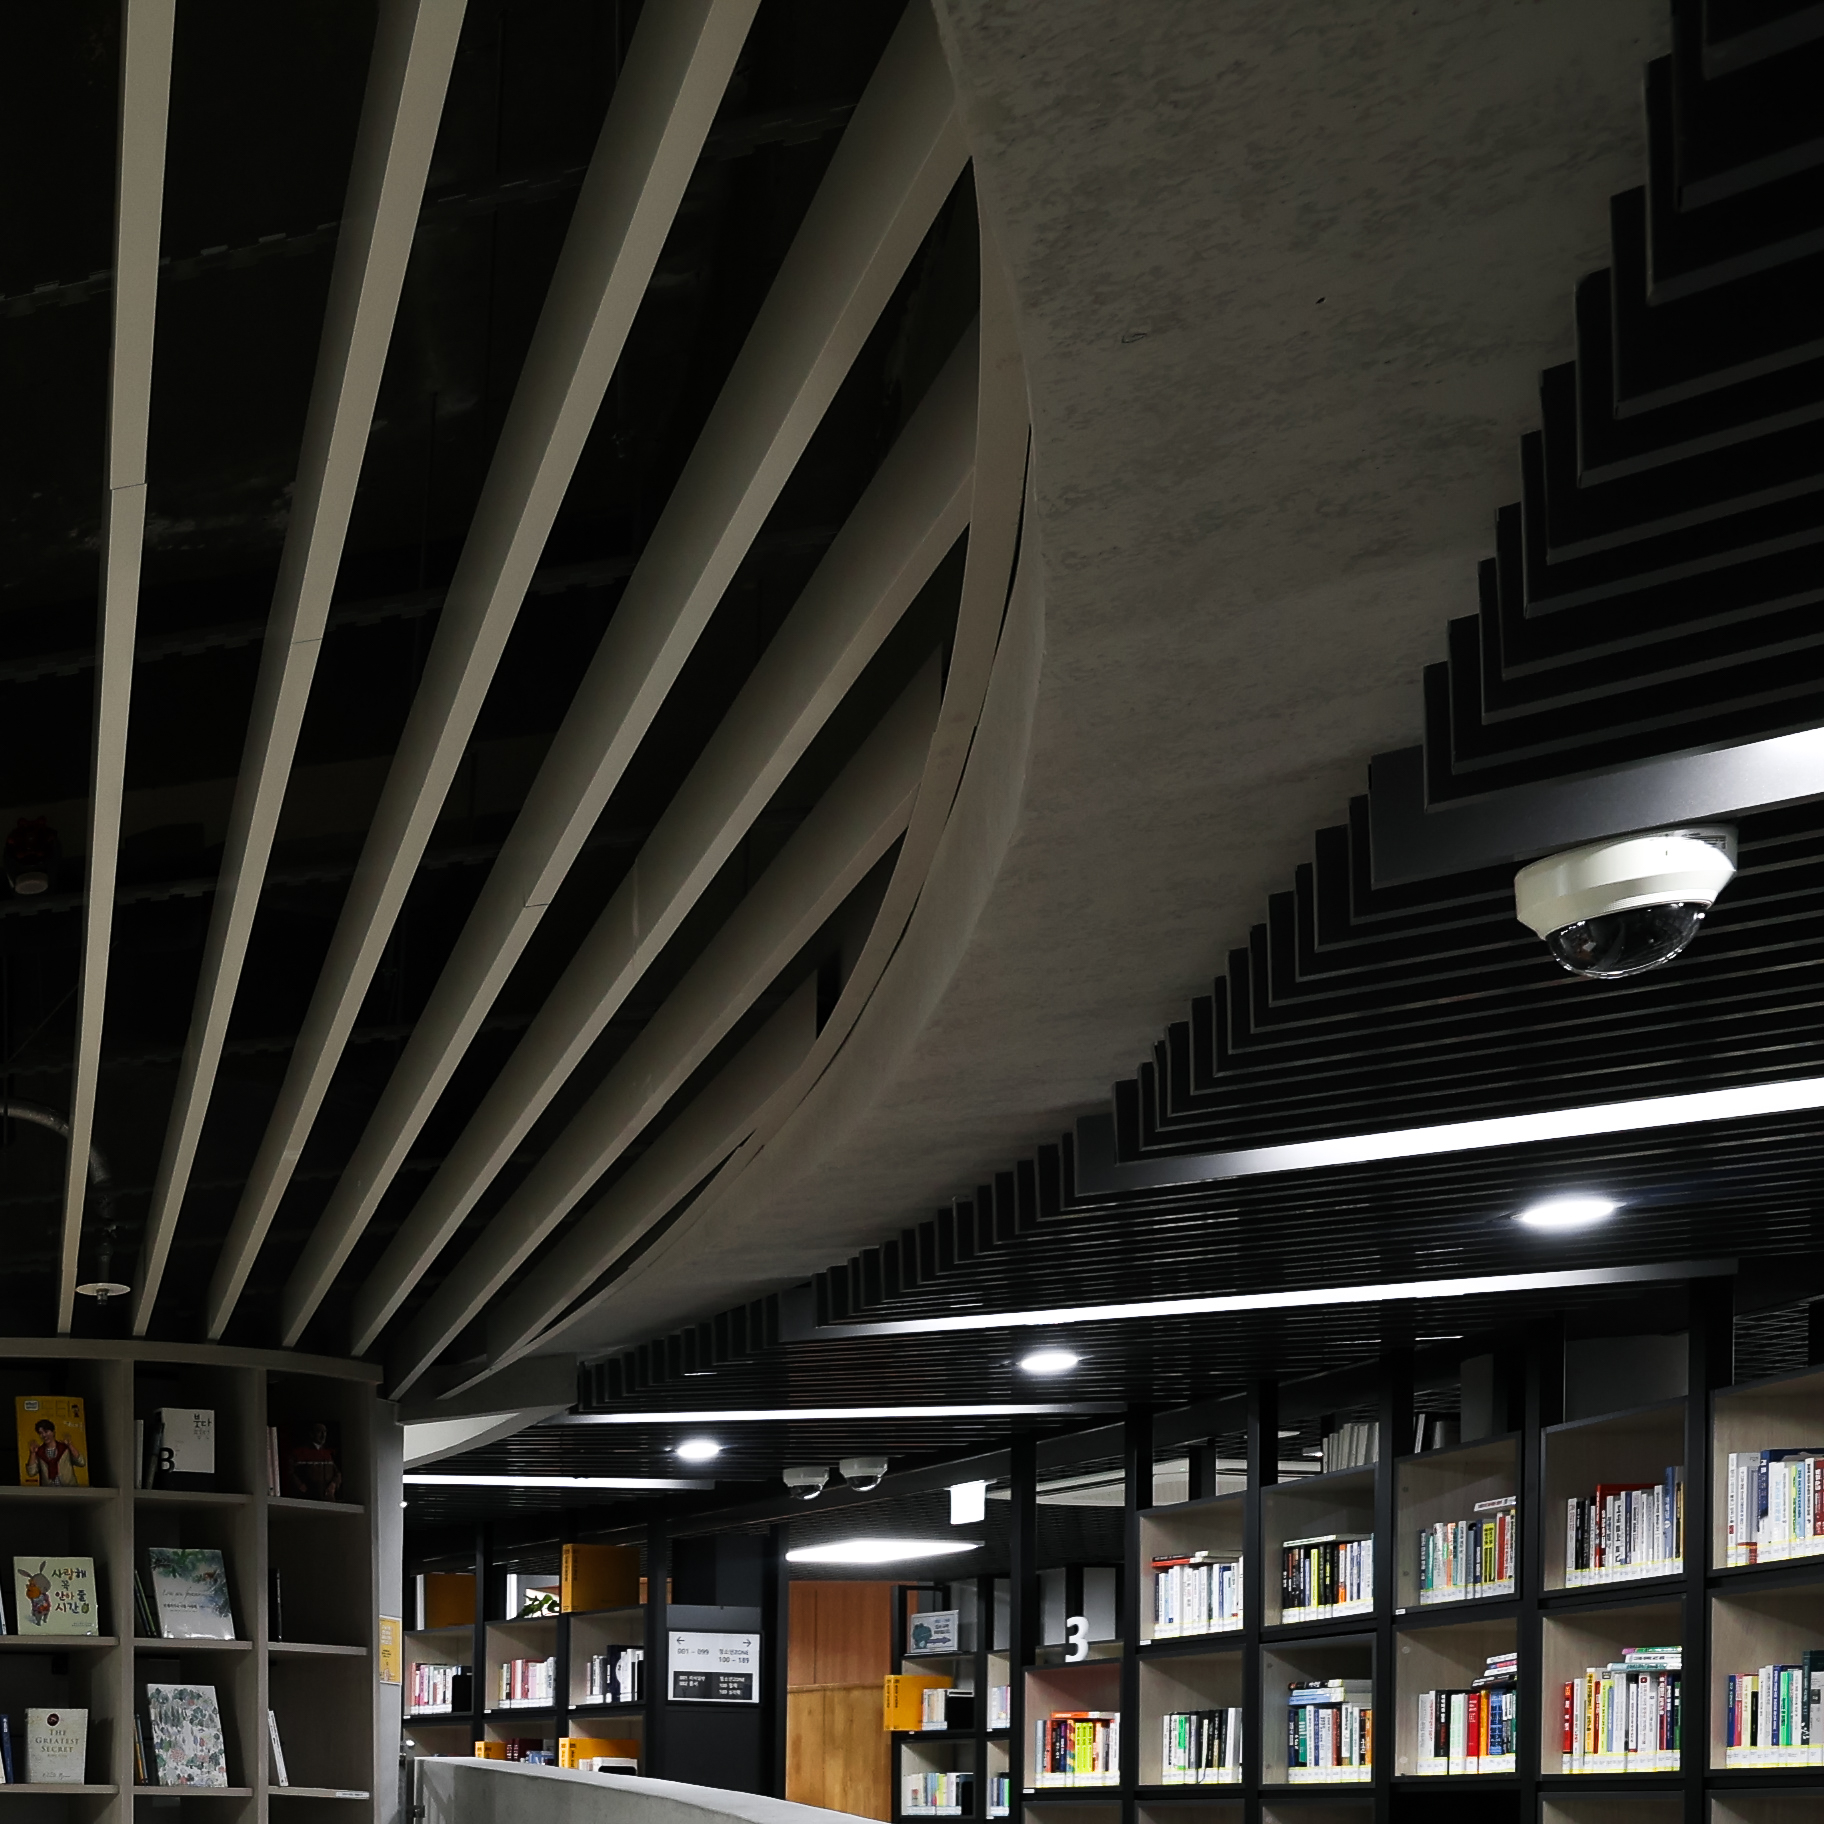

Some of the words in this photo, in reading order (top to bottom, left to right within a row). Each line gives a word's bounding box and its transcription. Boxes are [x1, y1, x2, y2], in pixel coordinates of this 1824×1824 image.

[192, 1413, 212, 1428] 붓다
[158, 1447, 174, 1473] B
[51, 1567, 87, 1581] 사랑해
[61, 1580, 70, 1591] 꼭
[54, 1591, 75, 1601] 안아
[77, 1589, 86, 1602] 줄
[54, 1602, 80, 1614] 시간
[1065, 1616, 1089, 1662] 3
[35, 1737, 79, 1745] GREATEST
[41, 1745, 74, 1753] SECRET
